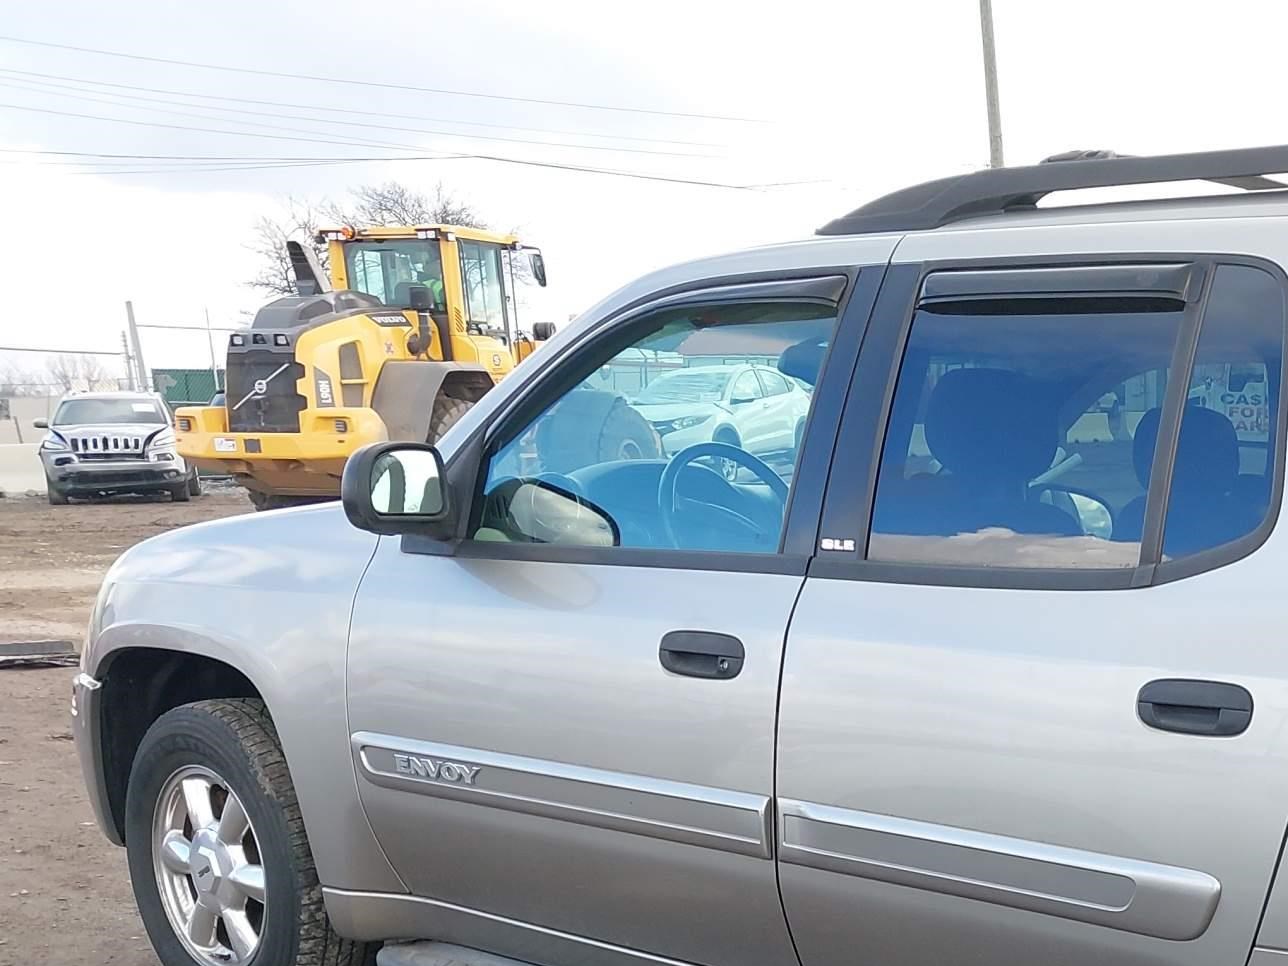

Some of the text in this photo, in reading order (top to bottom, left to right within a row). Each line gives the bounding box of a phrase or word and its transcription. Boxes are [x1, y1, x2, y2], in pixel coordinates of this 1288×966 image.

[1235, 420, 1268, 432] AR
[821, 538, 856, 551] SLE
[393, 753, 481, 785] ENVOY
